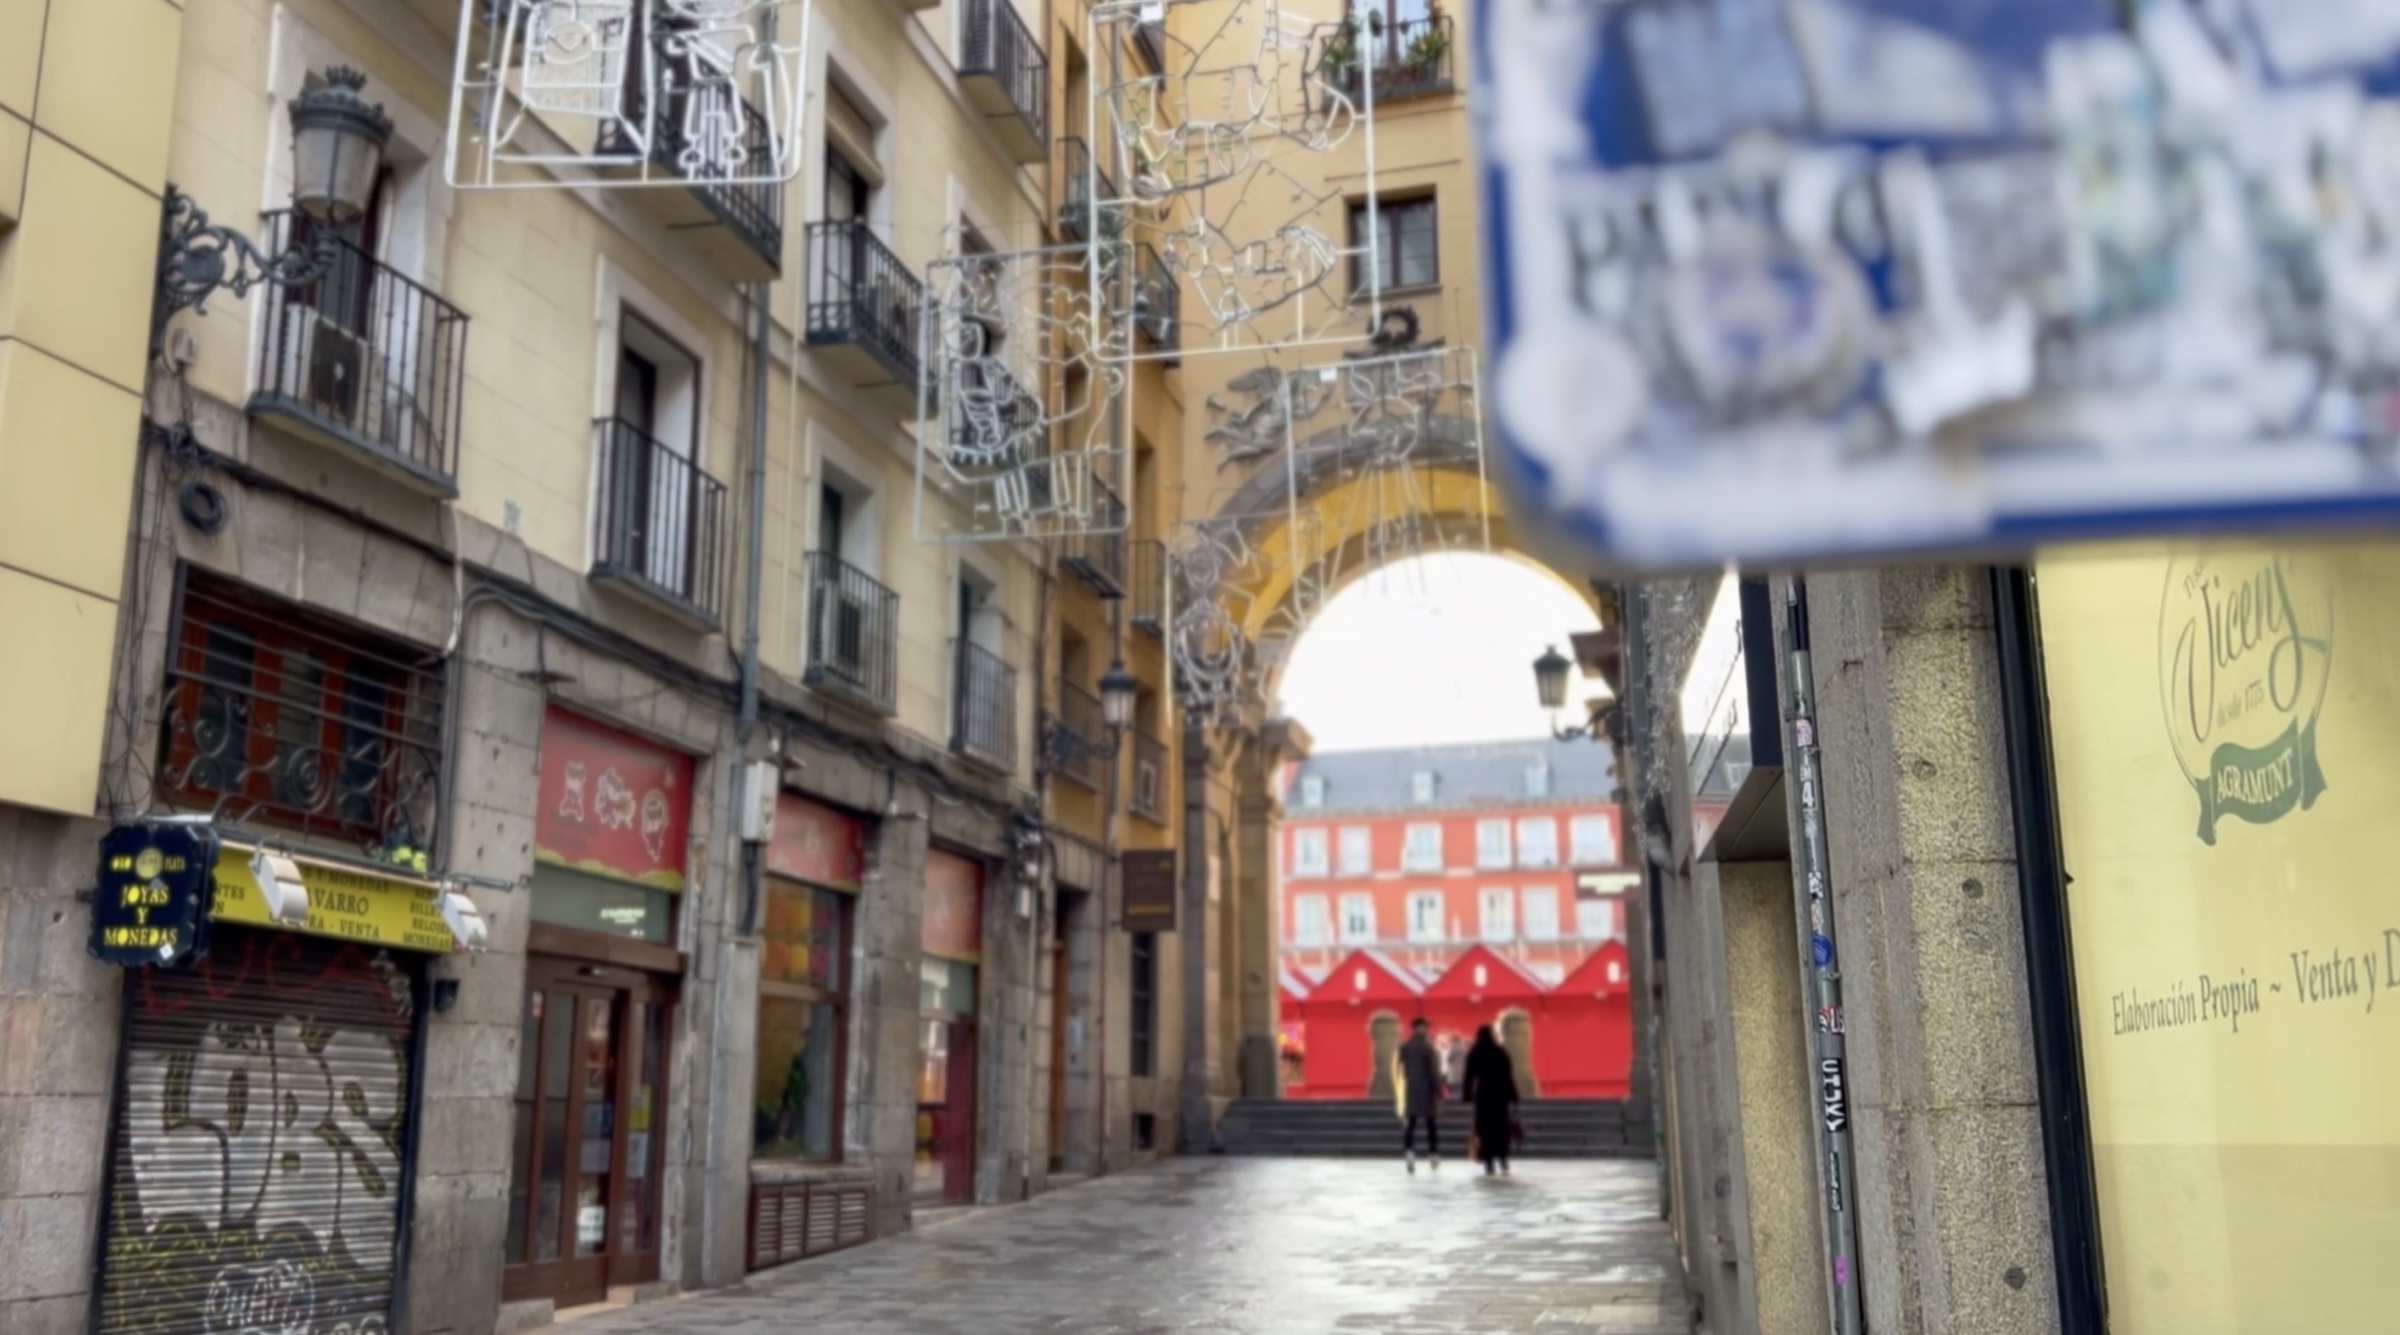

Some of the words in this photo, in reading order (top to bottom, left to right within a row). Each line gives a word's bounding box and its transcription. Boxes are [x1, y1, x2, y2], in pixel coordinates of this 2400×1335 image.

[2216, 747, 2294, 805] AGRAMUNT
[327, 868, 390, 895] MONEDAS
[121, 885, 170, 909] JOYAS
[137, 907, 149, 924] Y
[103, 926, 178, 947] MONEDAS
[339, 918, 380, 940] VENTA
[2111, 980, 2197, 1036] Elaboración
[2198, 966, 2260, 1034] Propia
[2289, 947, 2359, 1004] Venta
[2362, 950, 2378, 1015] y
